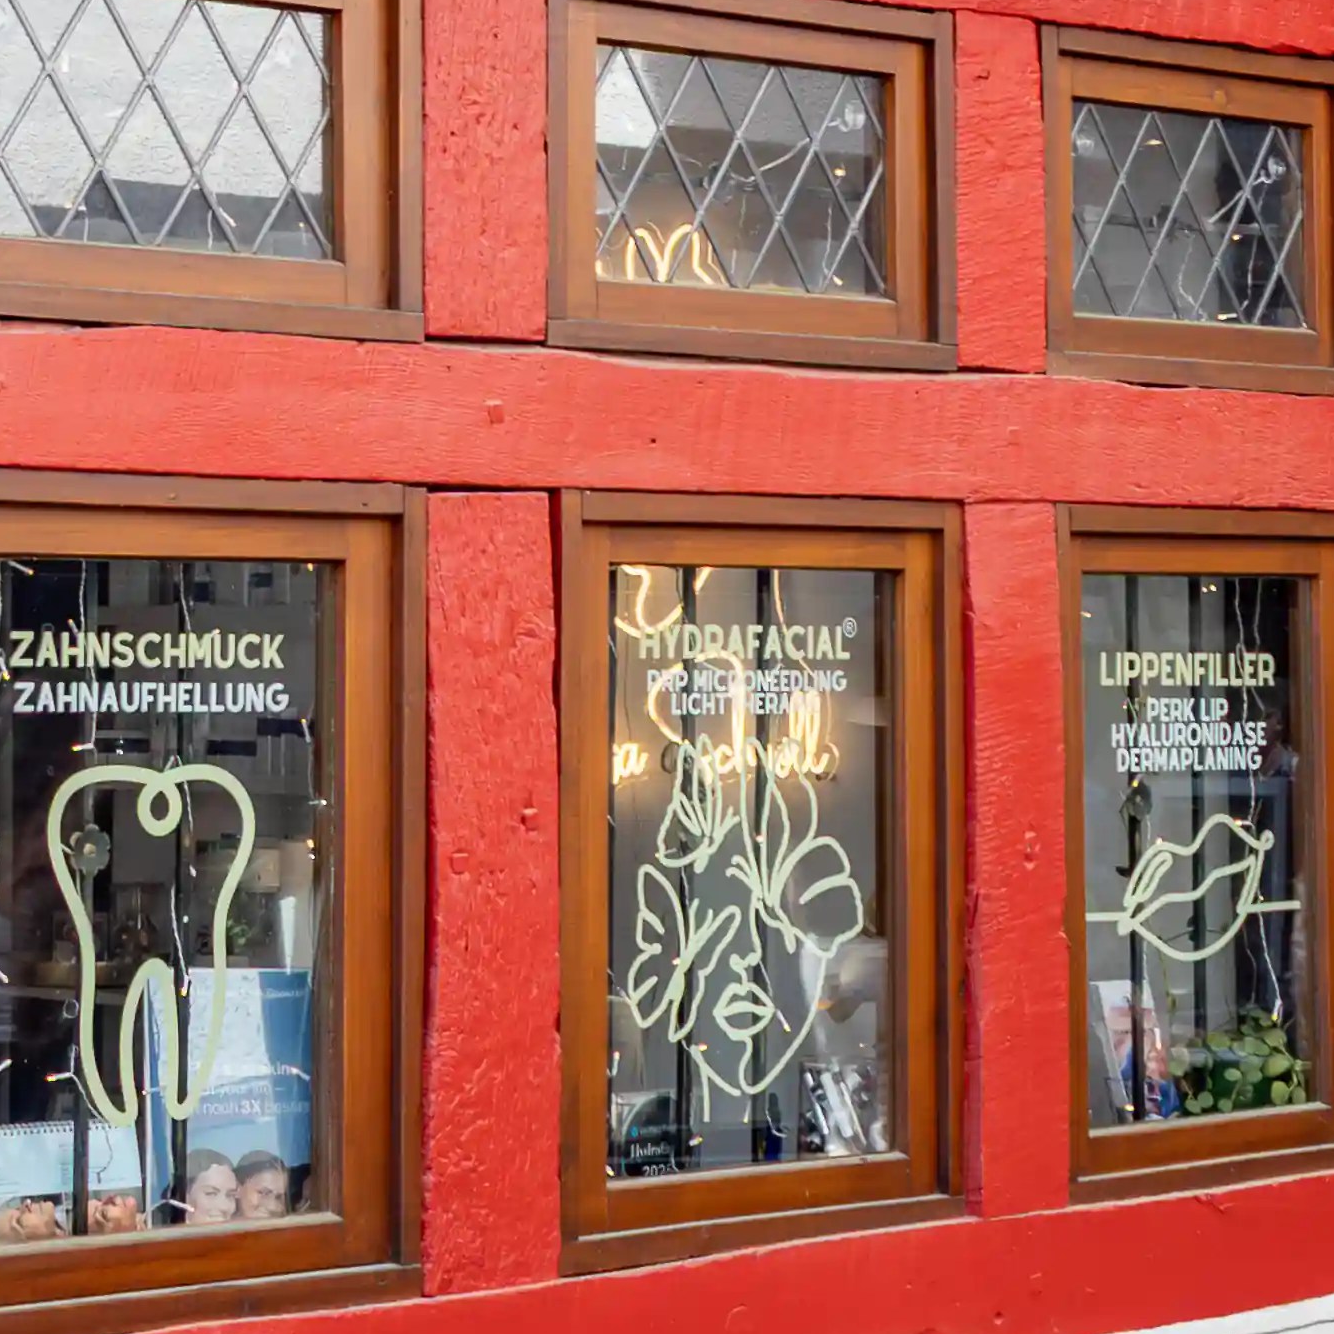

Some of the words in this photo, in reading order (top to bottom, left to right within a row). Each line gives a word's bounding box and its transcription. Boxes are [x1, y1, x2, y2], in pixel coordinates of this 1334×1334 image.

[8, 630, 285, 669] ZAHNSCHMUCK
[1099, 651, 1276, 687] LIPPENFILLER
[13, 681, 290, 713] ZAHNAUFHELLUNG
[1146, 696, 1196, 723] PERK
[1199, 696, 1229, 722] LIP
[1110, 721, 1268, 748] HYALURONIDASE
[1116, 746, 1263, 773] DERMAPLANING
